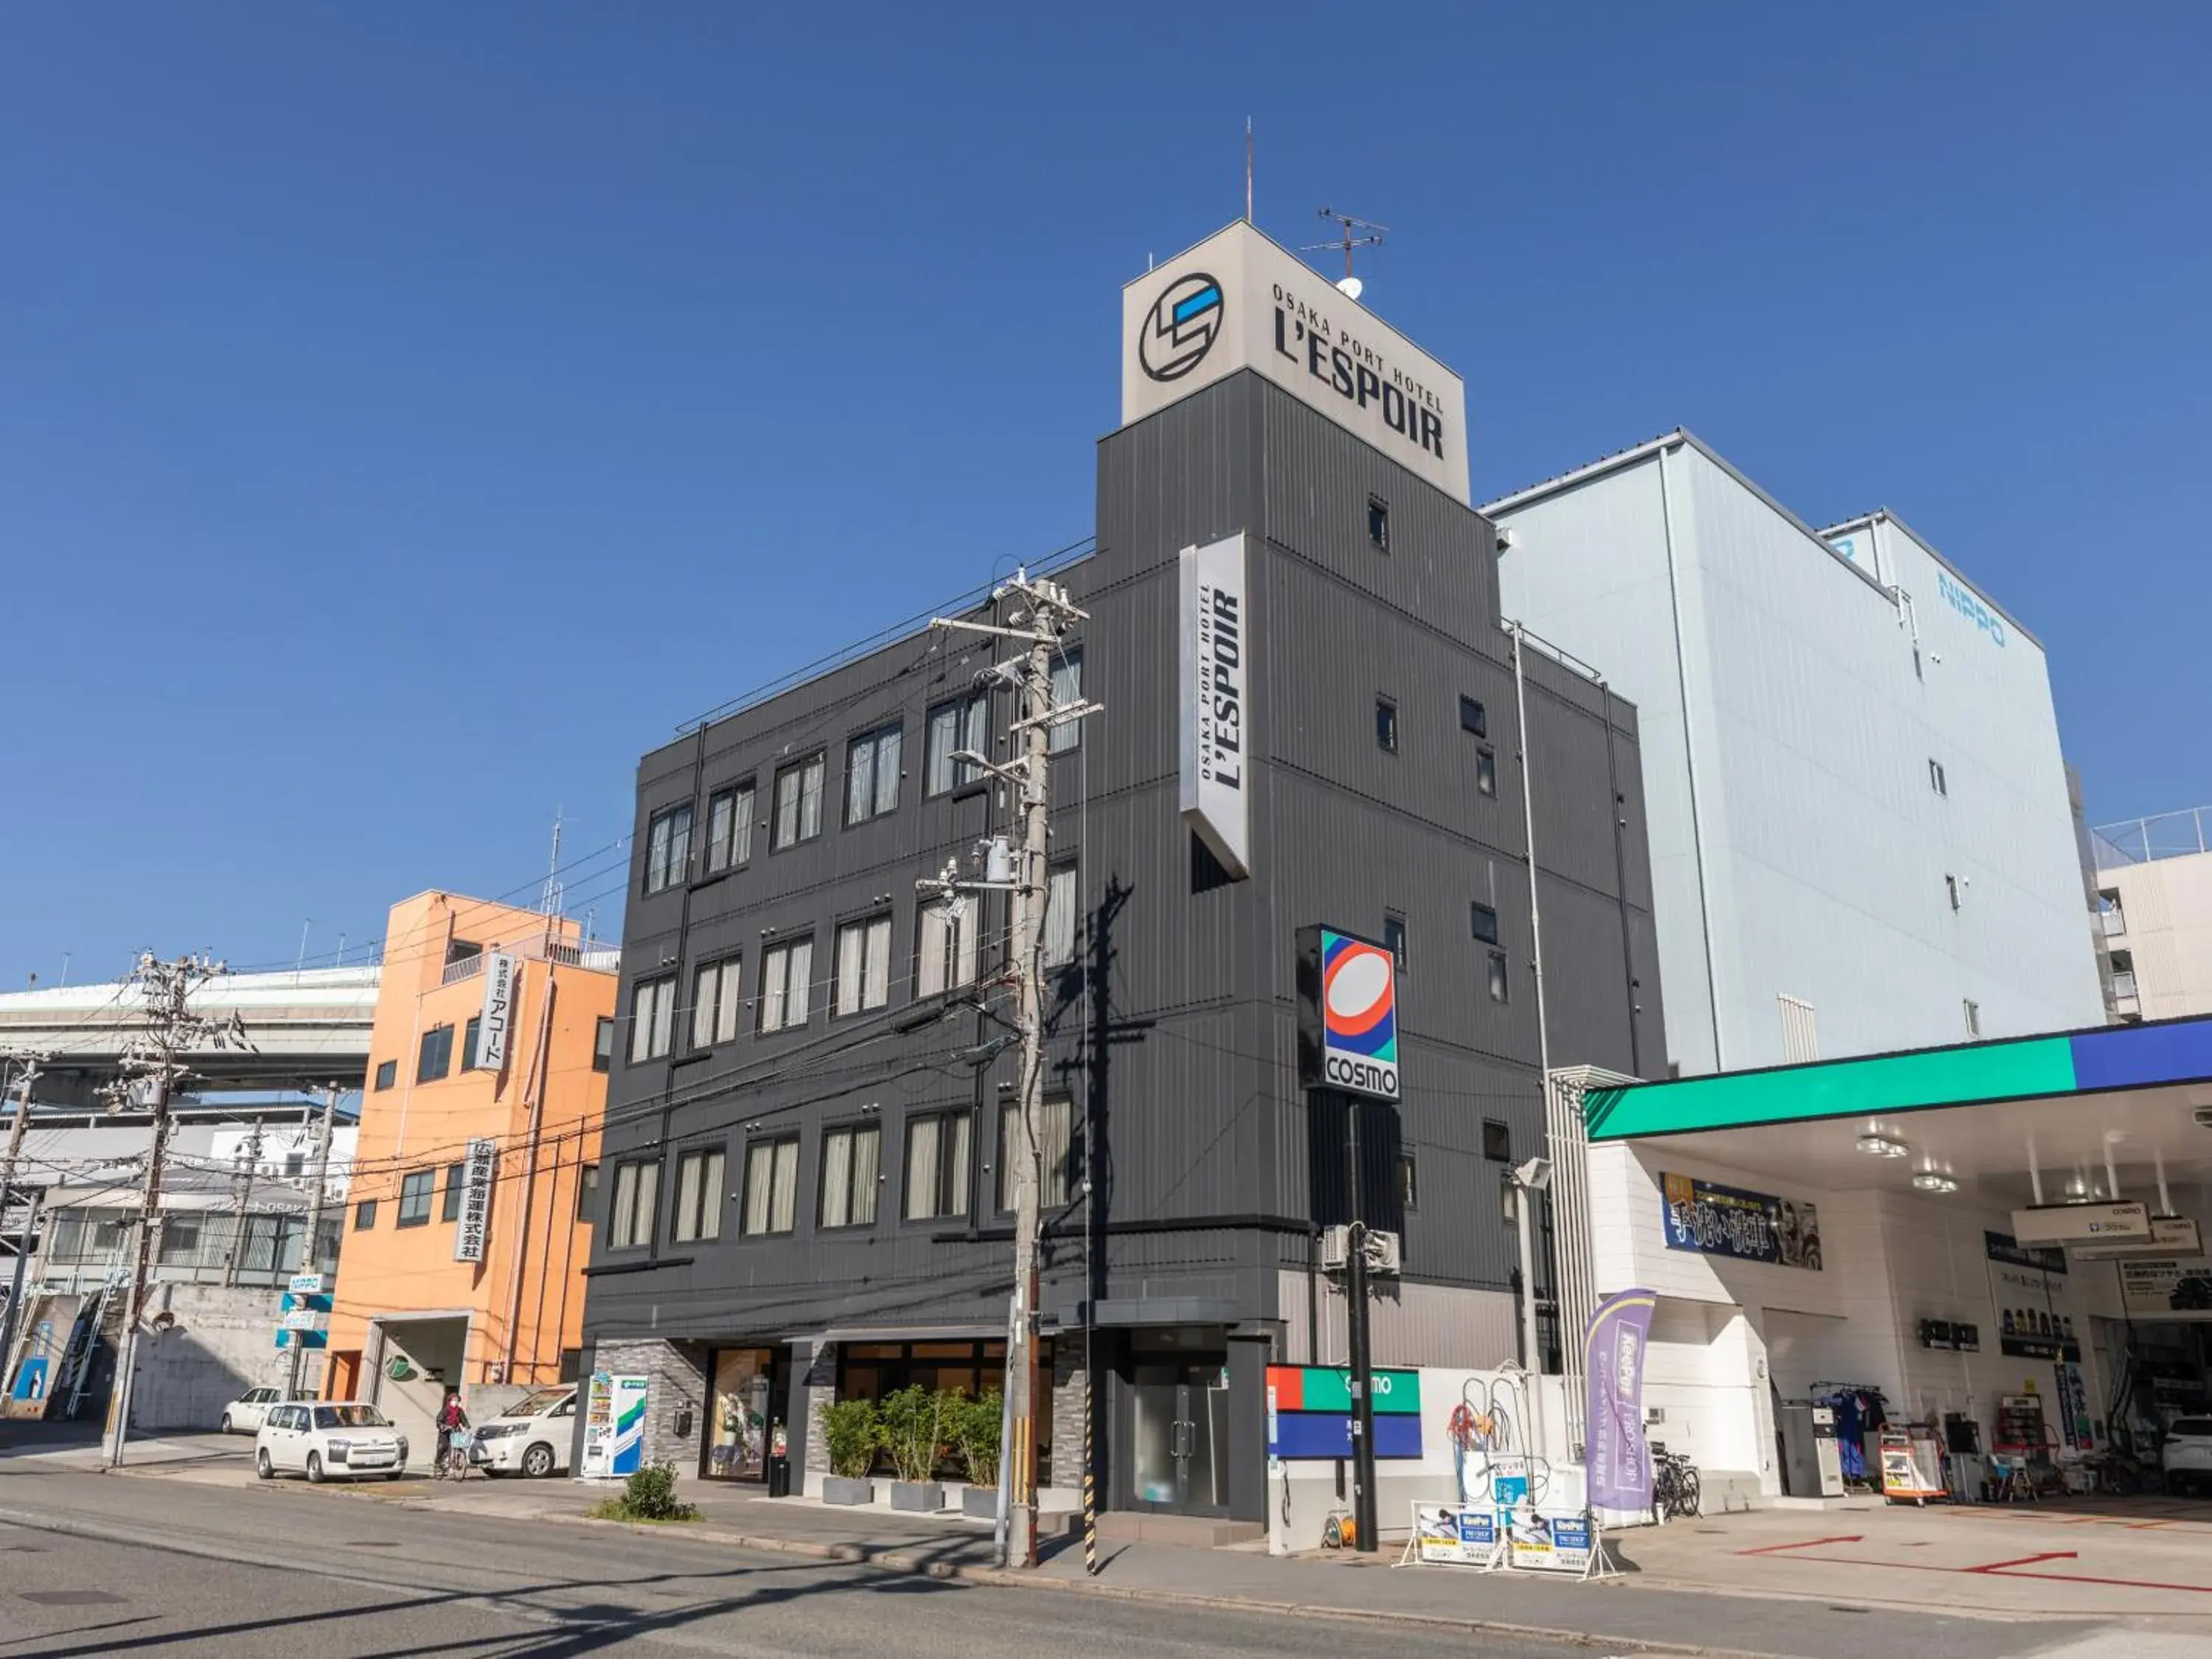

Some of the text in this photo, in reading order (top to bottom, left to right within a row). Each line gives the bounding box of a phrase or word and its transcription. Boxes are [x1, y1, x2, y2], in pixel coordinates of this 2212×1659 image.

[1273, 283, 1444, 414] OSAKA PORT HOTEL
[1274, 306, 1444, 461] L'ESPOIR
[1937, 572, 2006, 647] NIPPO
[1200, 583, 1211, 780] OSAKA PORT HOTEL
[1214, 587, 1241, 791] L'ESPOIR
[1326, 1057, 1397, 1094] COSMO
[1345, 1375, 1392, 1395] CMO
